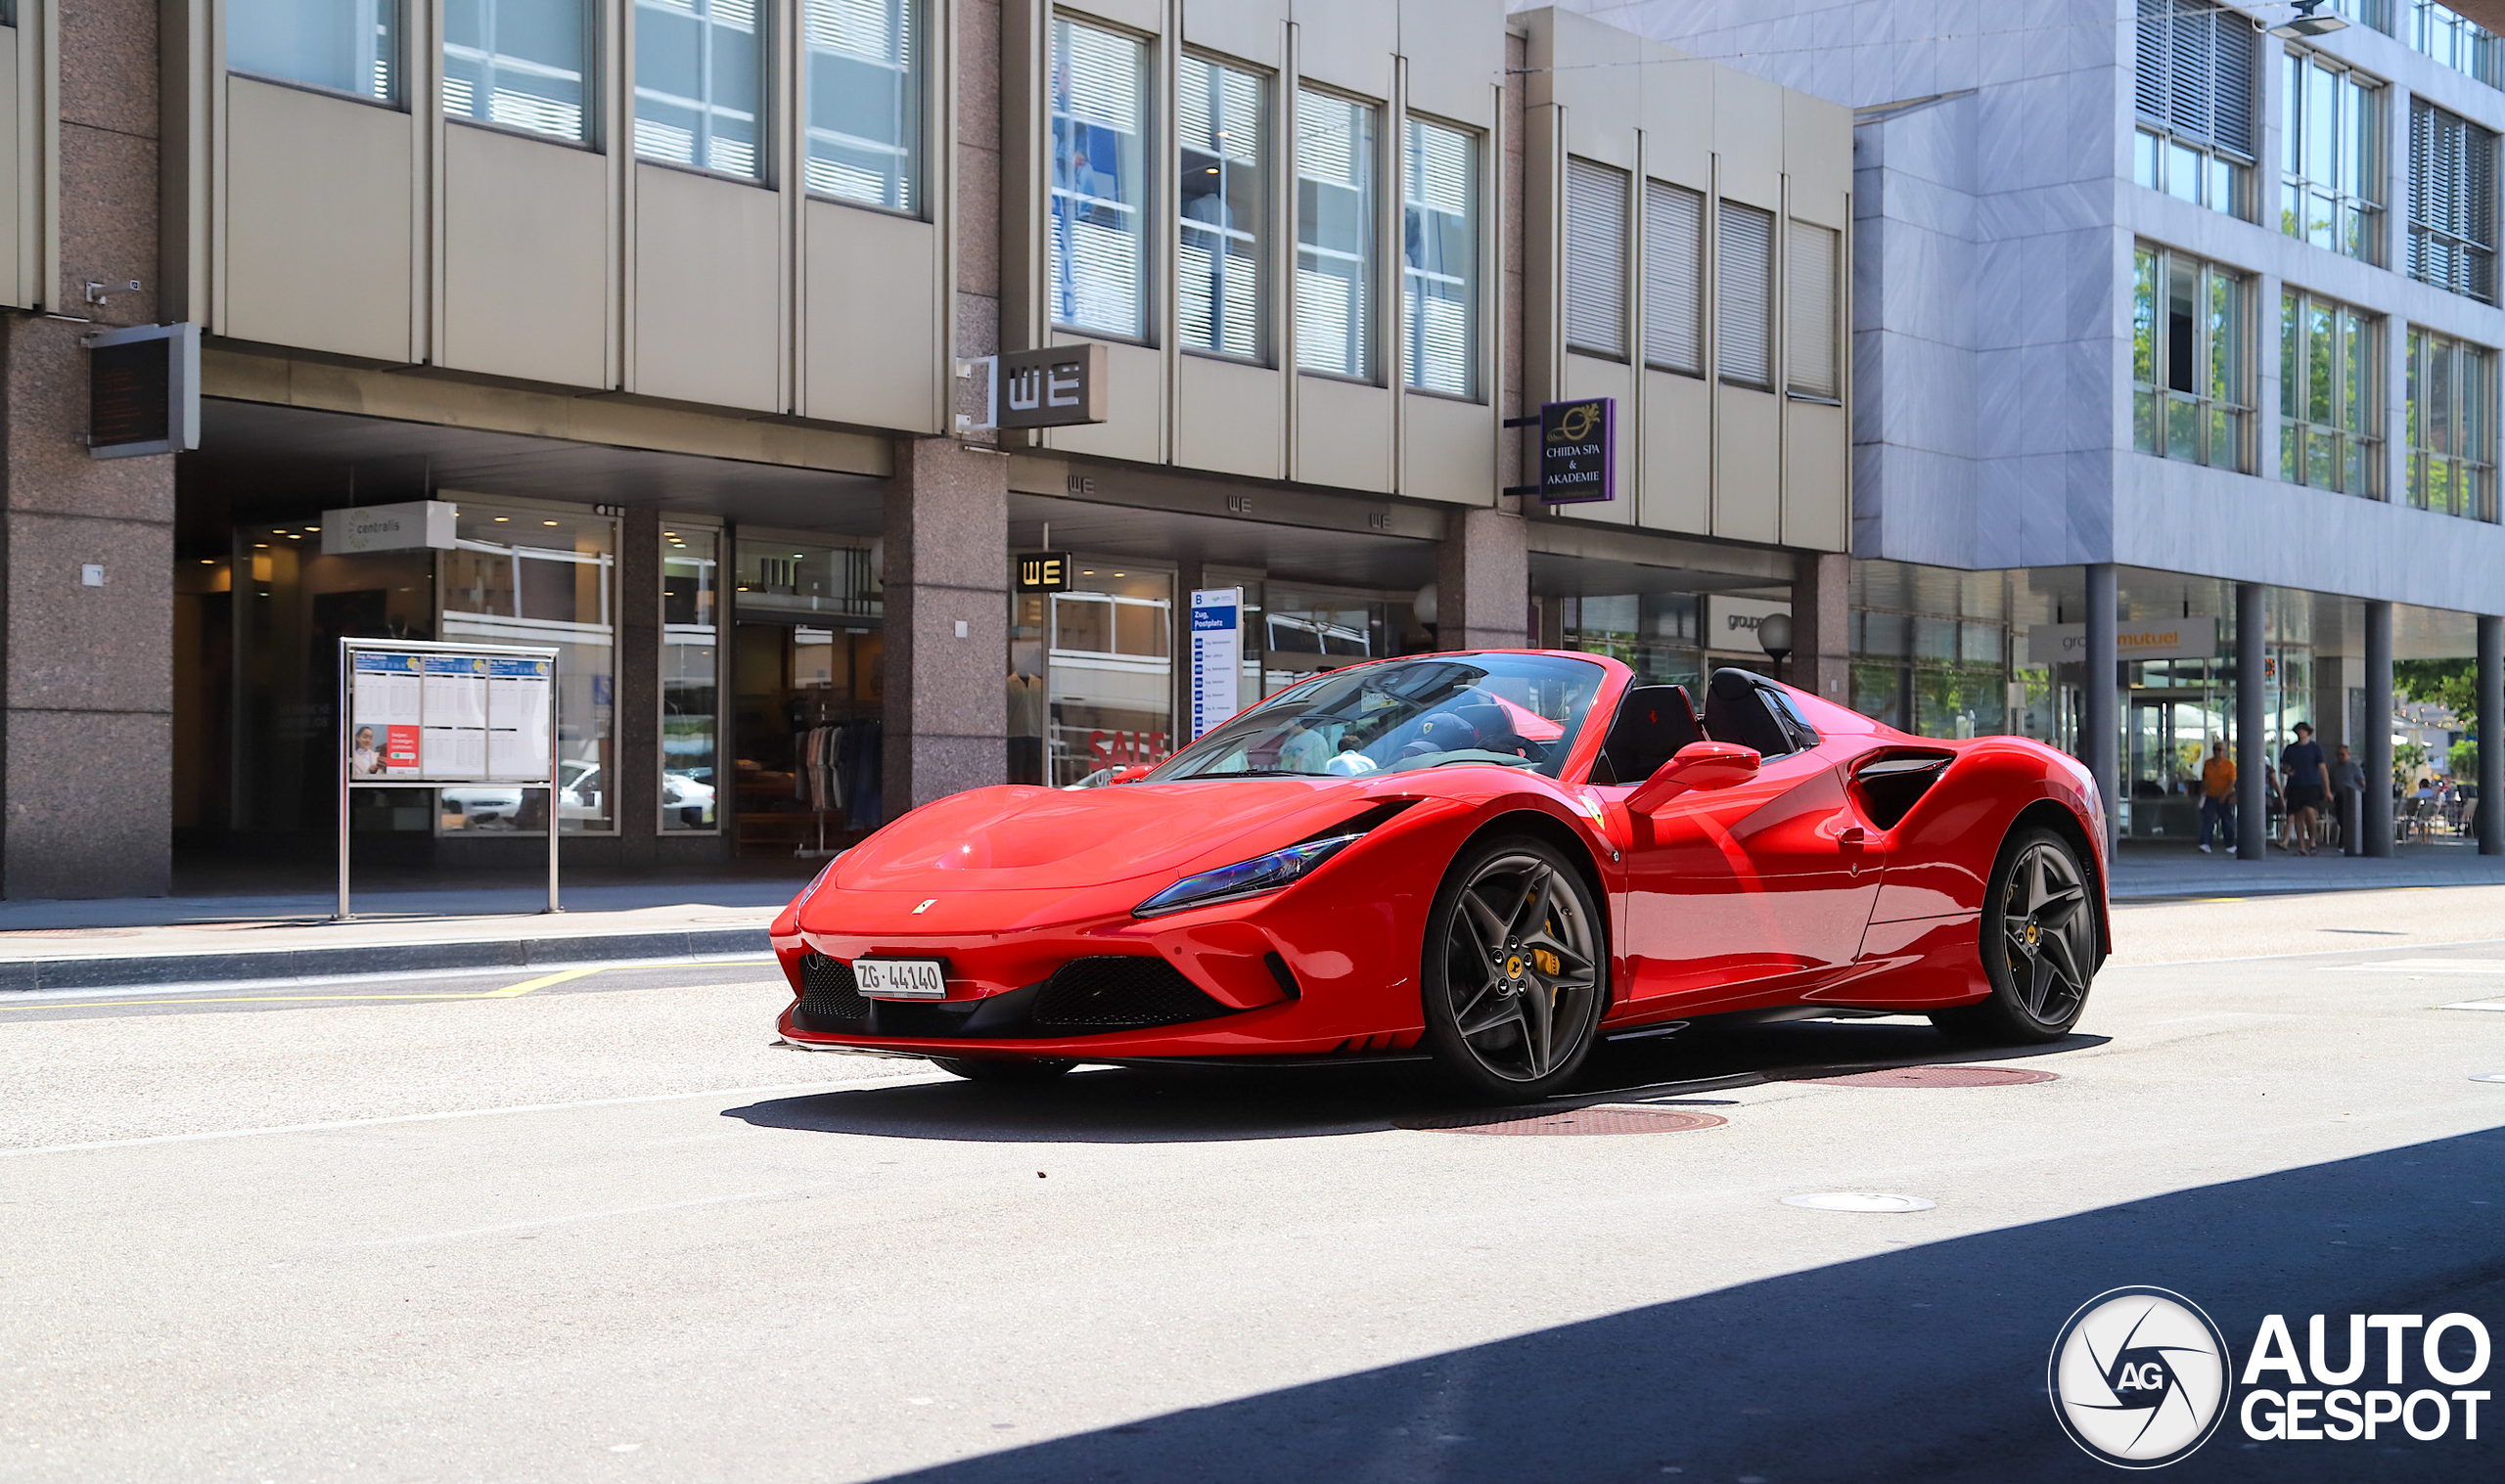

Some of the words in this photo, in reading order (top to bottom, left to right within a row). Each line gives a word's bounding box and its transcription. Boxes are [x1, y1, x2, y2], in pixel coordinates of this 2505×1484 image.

[1009, 361, 1079, 410] WE
[1546, 446, 1581, 458] CHIIDA
[1583, 444, 1601, 455] SPA
[1569, 459, 1577, 470] &
[1068, 475, 1095, 494] WE
[1547, 471, 1600, 485] AKADEMIE
[1228, 495, 1252, 513] WE
[356, 519, 400, 534] centralis
[1023, 560, 1061, 585] WE
[1196, 594, 1203, 605] B
[1194, 619, 1223, 629] Postplatz
[2117, 631, 2179, 646] mutuel
